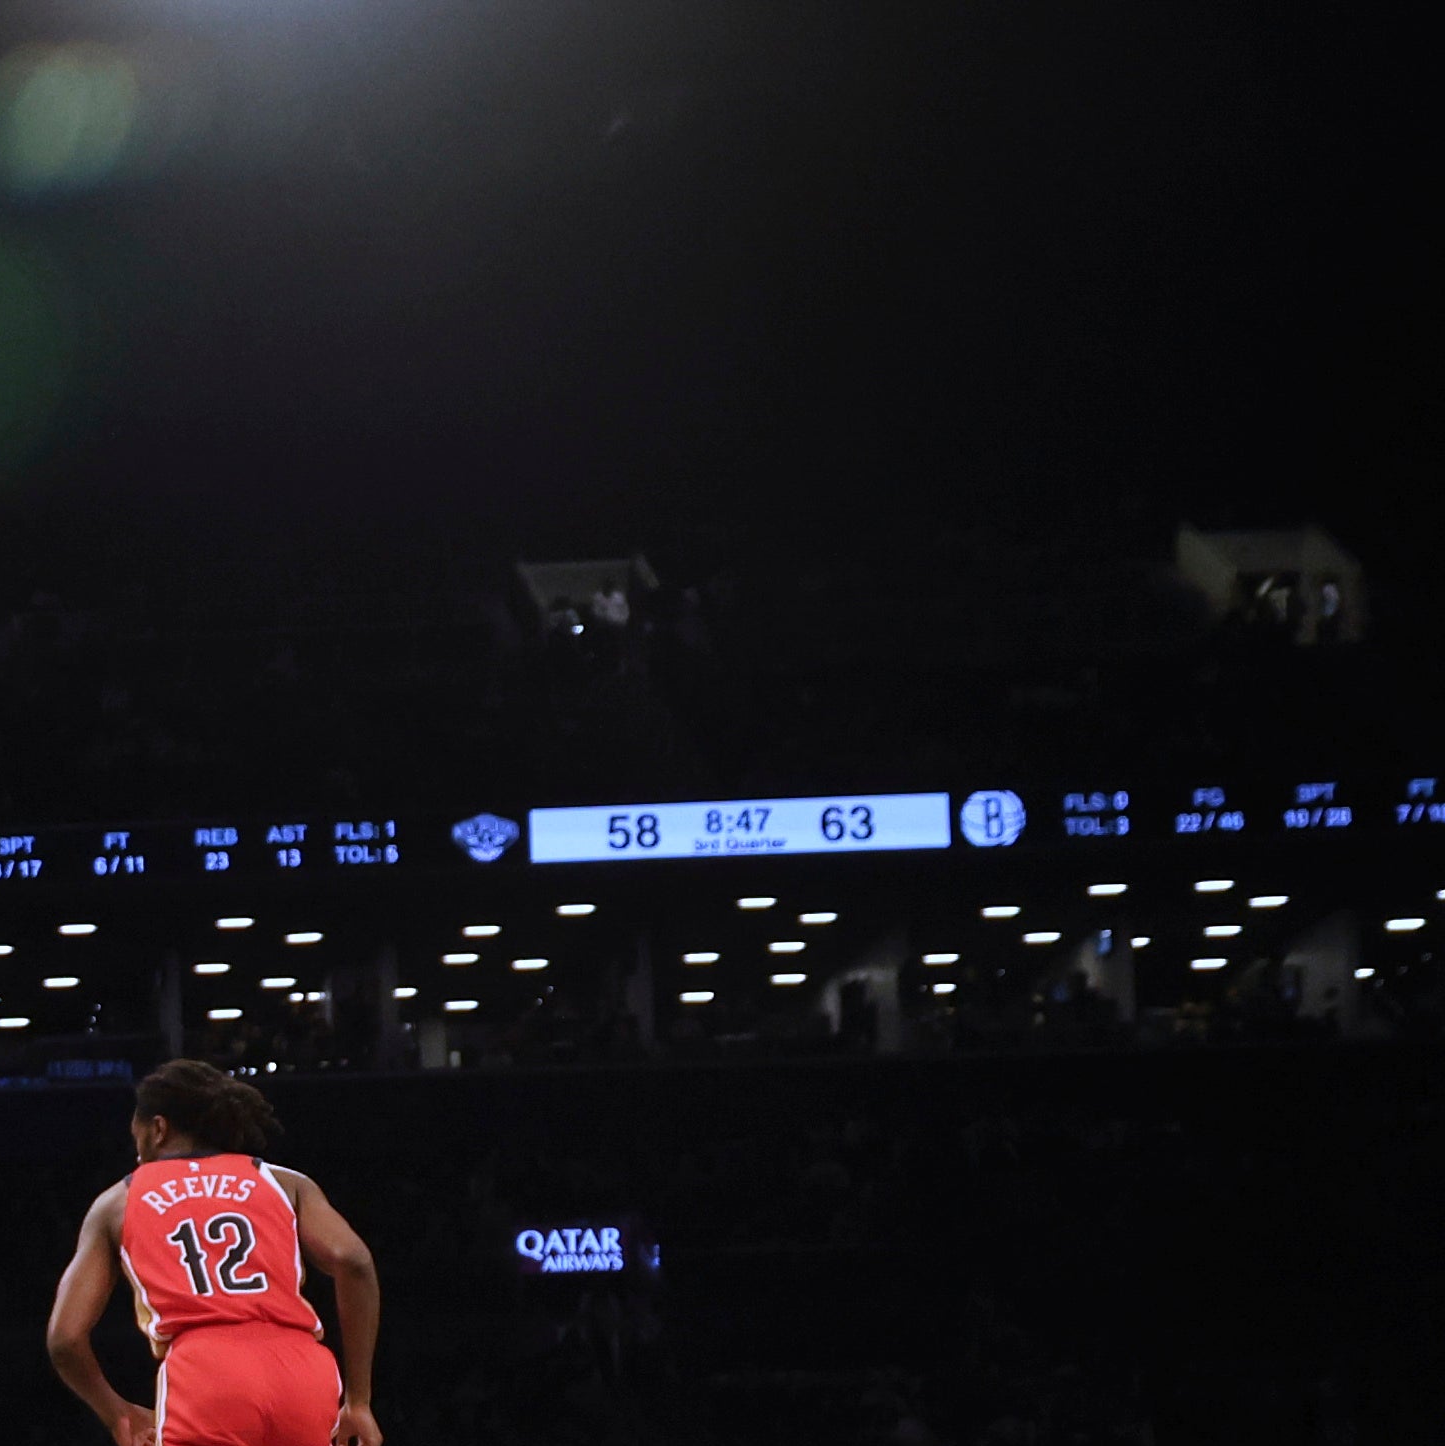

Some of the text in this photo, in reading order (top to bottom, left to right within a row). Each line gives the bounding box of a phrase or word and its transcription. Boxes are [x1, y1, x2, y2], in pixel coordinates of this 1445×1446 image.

[608, 814, 661, 850] 58
[706, 808, 772, 834] 8:47
[820, 806, 875, 842] 63
[103, 831, 131, 850] FT
[141, 1174, 257, 1216] REEVES
[165, 1211, 269, 1297] 12
[515, 1226, 623, 1262] QATAR
[541, 1252, 625, 1273] AIRWAYS
